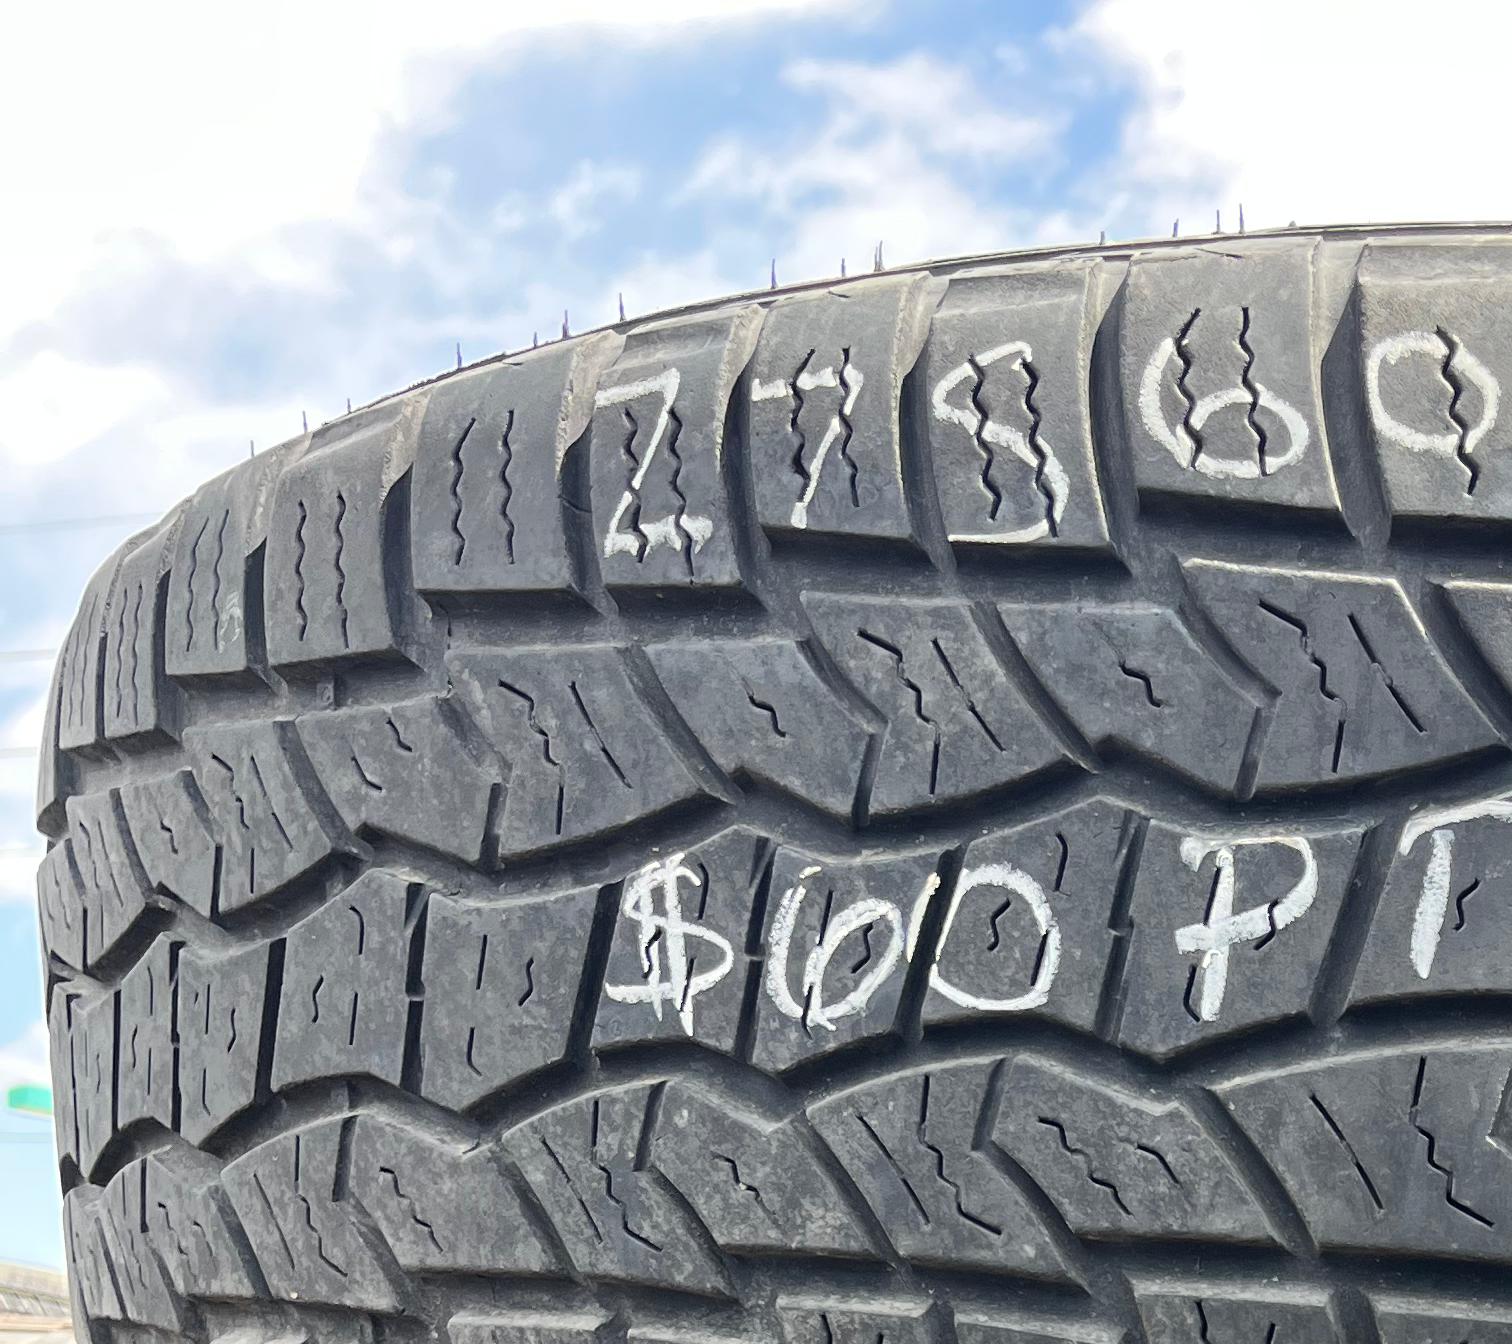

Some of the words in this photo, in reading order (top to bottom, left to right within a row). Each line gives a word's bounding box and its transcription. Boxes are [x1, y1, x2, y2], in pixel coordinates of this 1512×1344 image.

[596, 340, 1070, 558] 275
[1139, 329, 1501, 479] 60
[604, 852, 1062, 1036] $60
